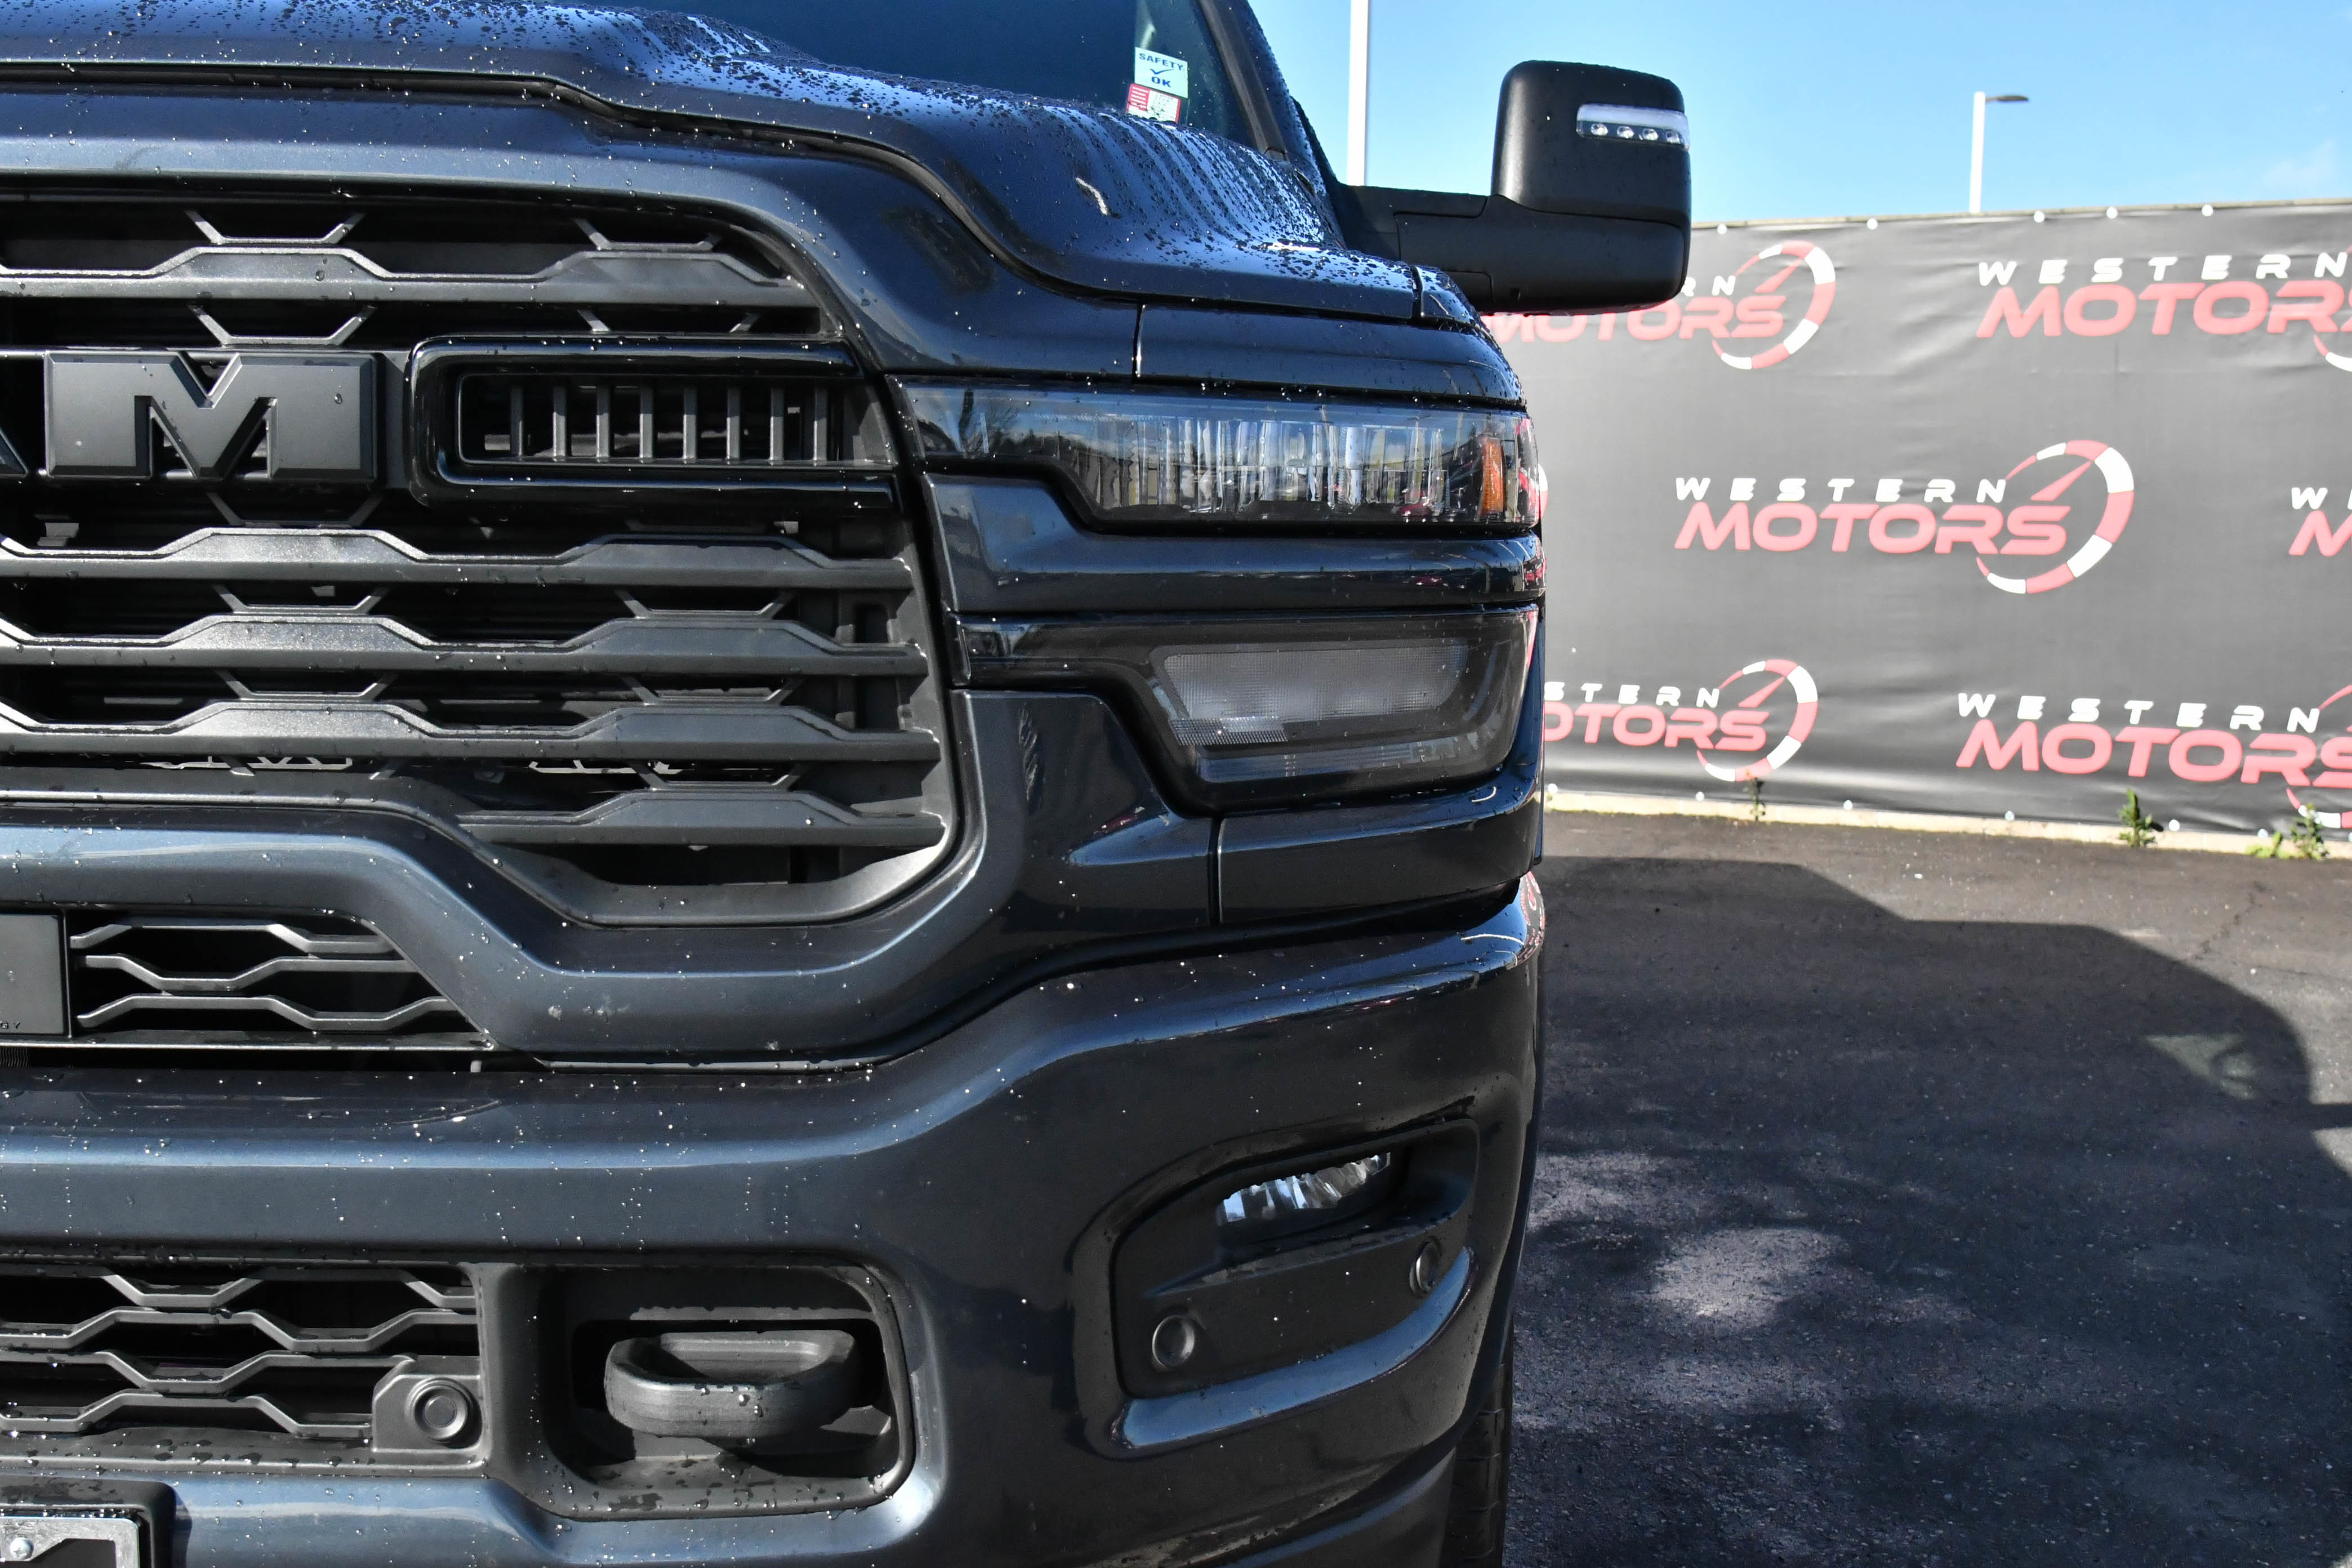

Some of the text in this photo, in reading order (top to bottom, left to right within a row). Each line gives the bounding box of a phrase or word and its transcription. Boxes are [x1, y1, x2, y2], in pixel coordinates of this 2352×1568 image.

[1139, 53, 1183, 71] SAFETY
[1151, 76, 1171, 88] OK
[1979, 252, 2347, 286] WESTERN
[1976, 280, 2352, 338] MOTOR
[1676, 477, 2006, 503] WESTERN
[1674, 501, 2072, 556] MOTORS
[1544, 681, 1720, 708] STERN
[1544, 701, 1770, 752] OTORS
[1958, 693, 2319, 733] WESTERN
